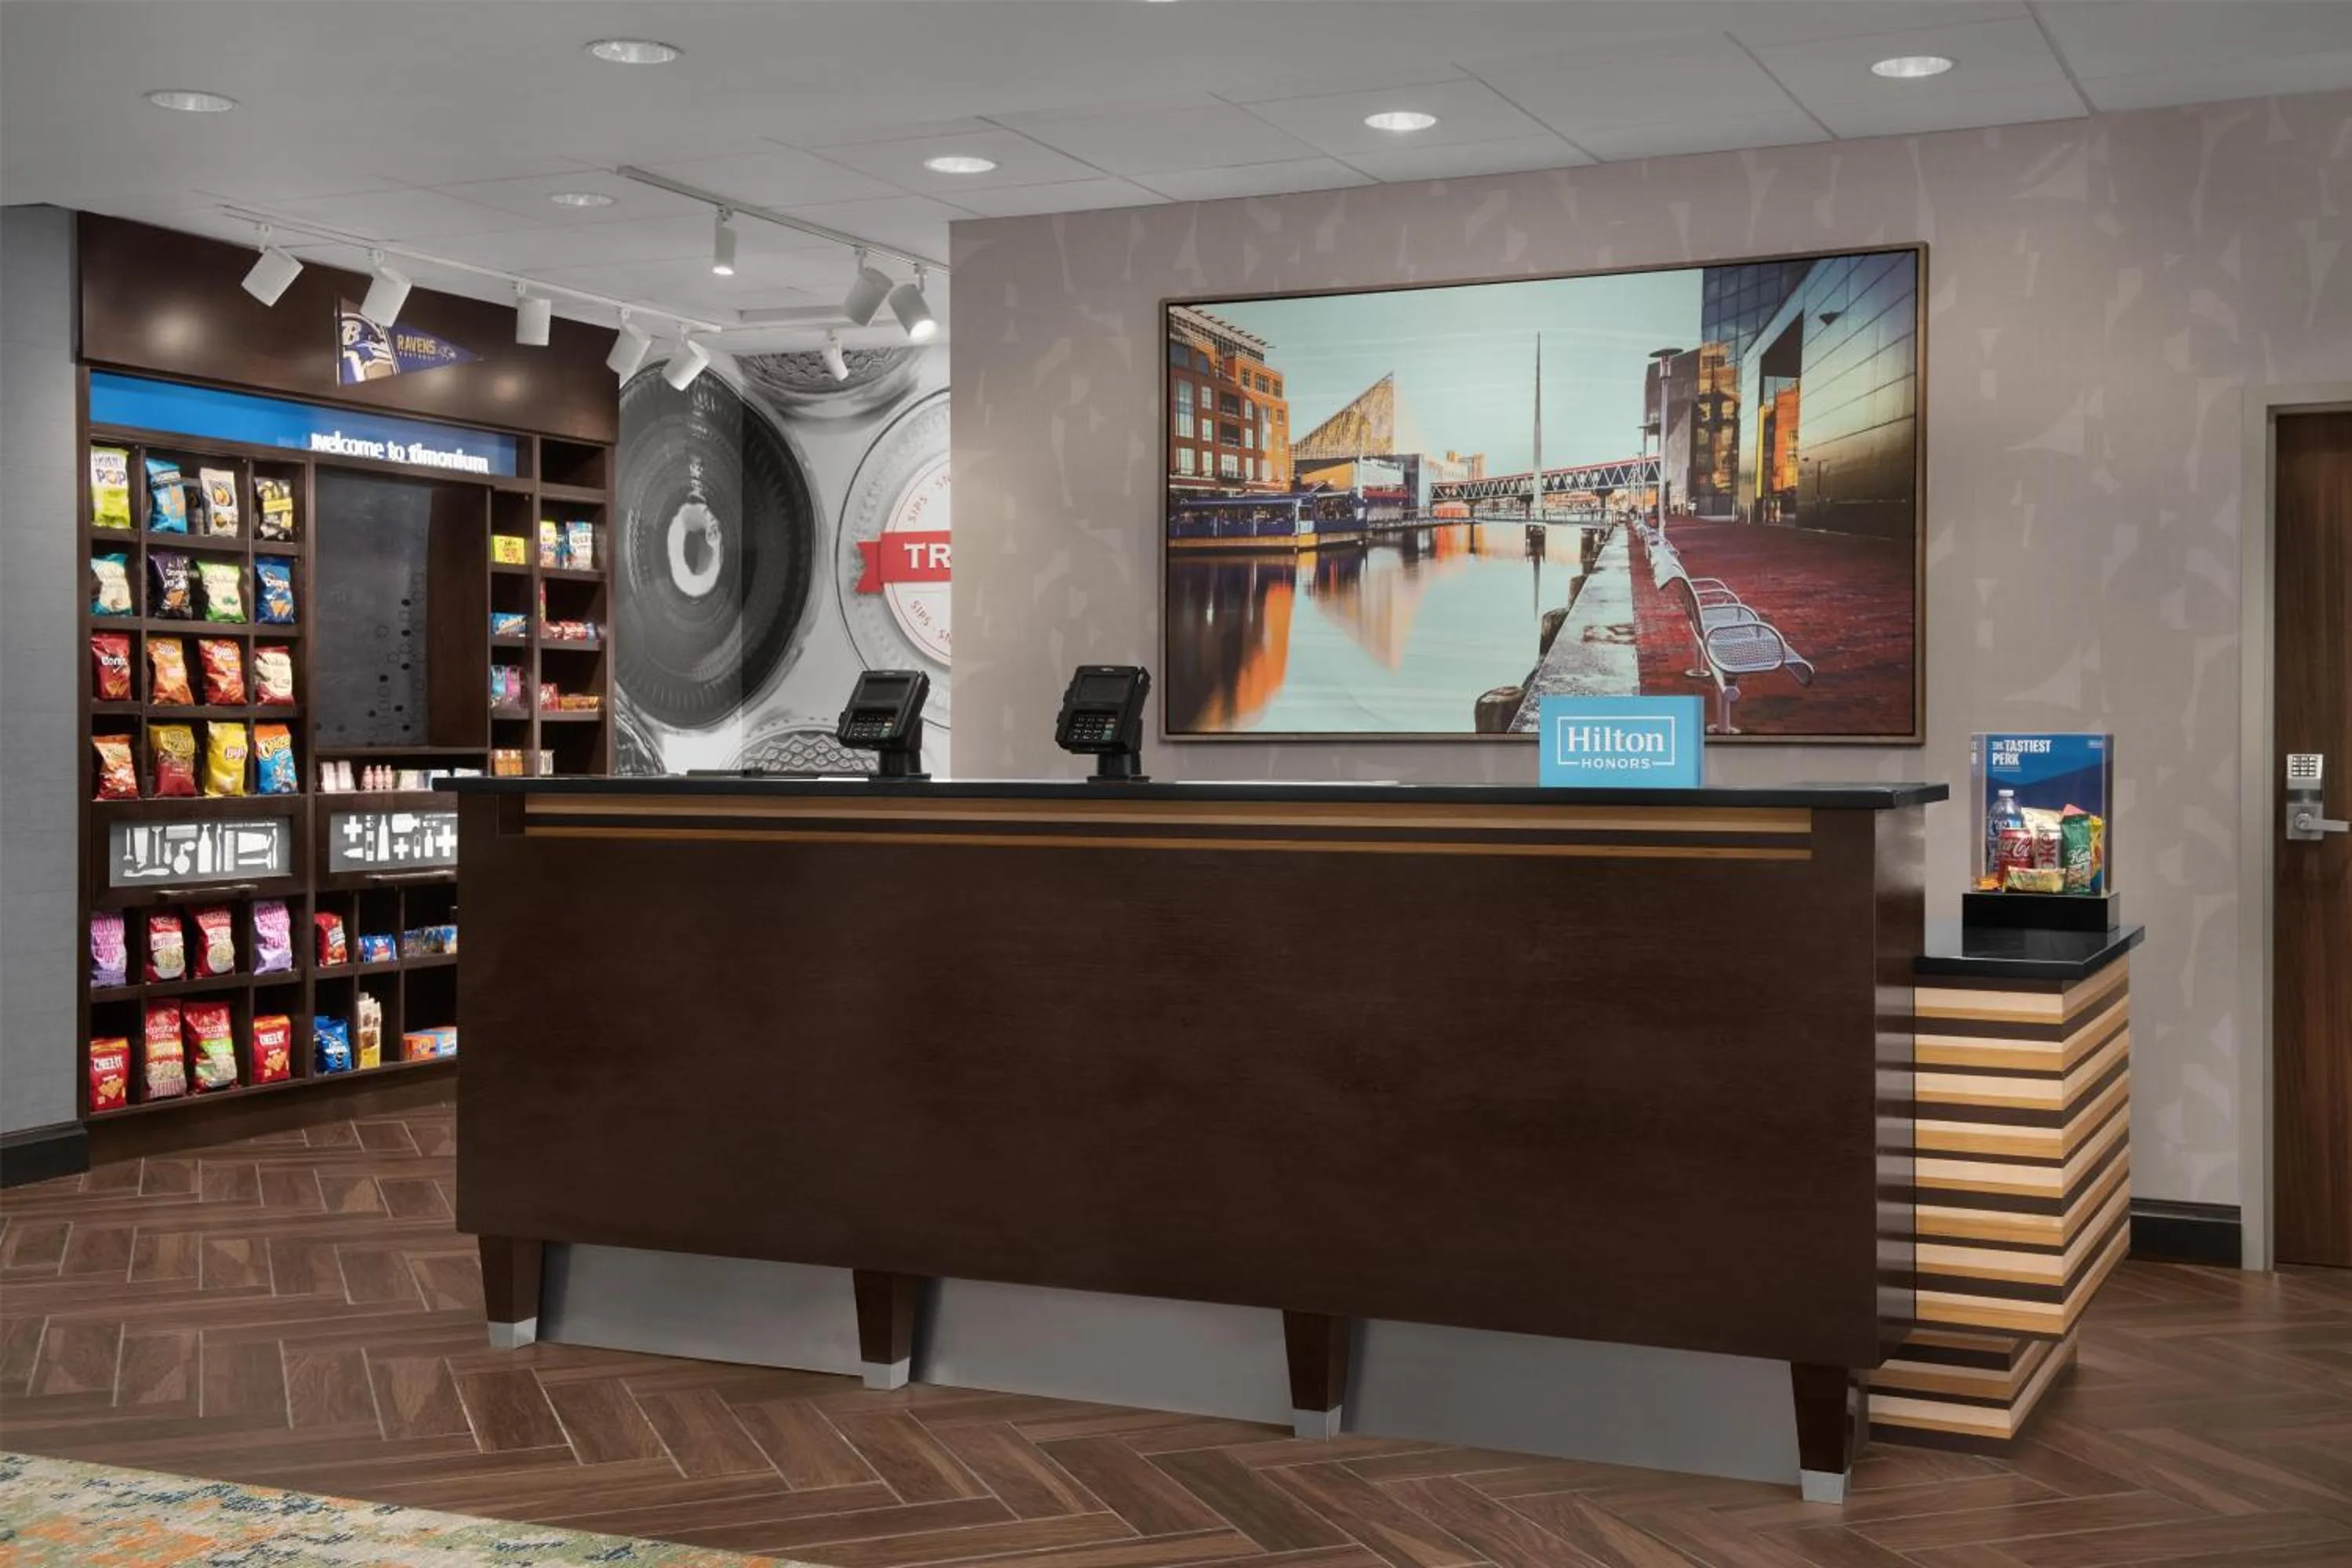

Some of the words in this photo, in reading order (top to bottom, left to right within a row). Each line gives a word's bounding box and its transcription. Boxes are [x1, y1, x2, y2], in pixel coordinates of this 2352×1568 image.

[397, 333, 437, 354] RAVENS
[310, 430, 385, 459] welcome
[387, 441, 405, 461] to
[408, 442, 489, 474] timonium
[907, 494, 928, 524] SIPS
[911, 600, 931, 627] SIPS
[1568, 726, 1665, 753] Hilton
[2005, 739, 2052, 753] TASTIEST
[1581, 758, 1651, 769] HONORS
[1992, 753, 2020, 765] PERK
